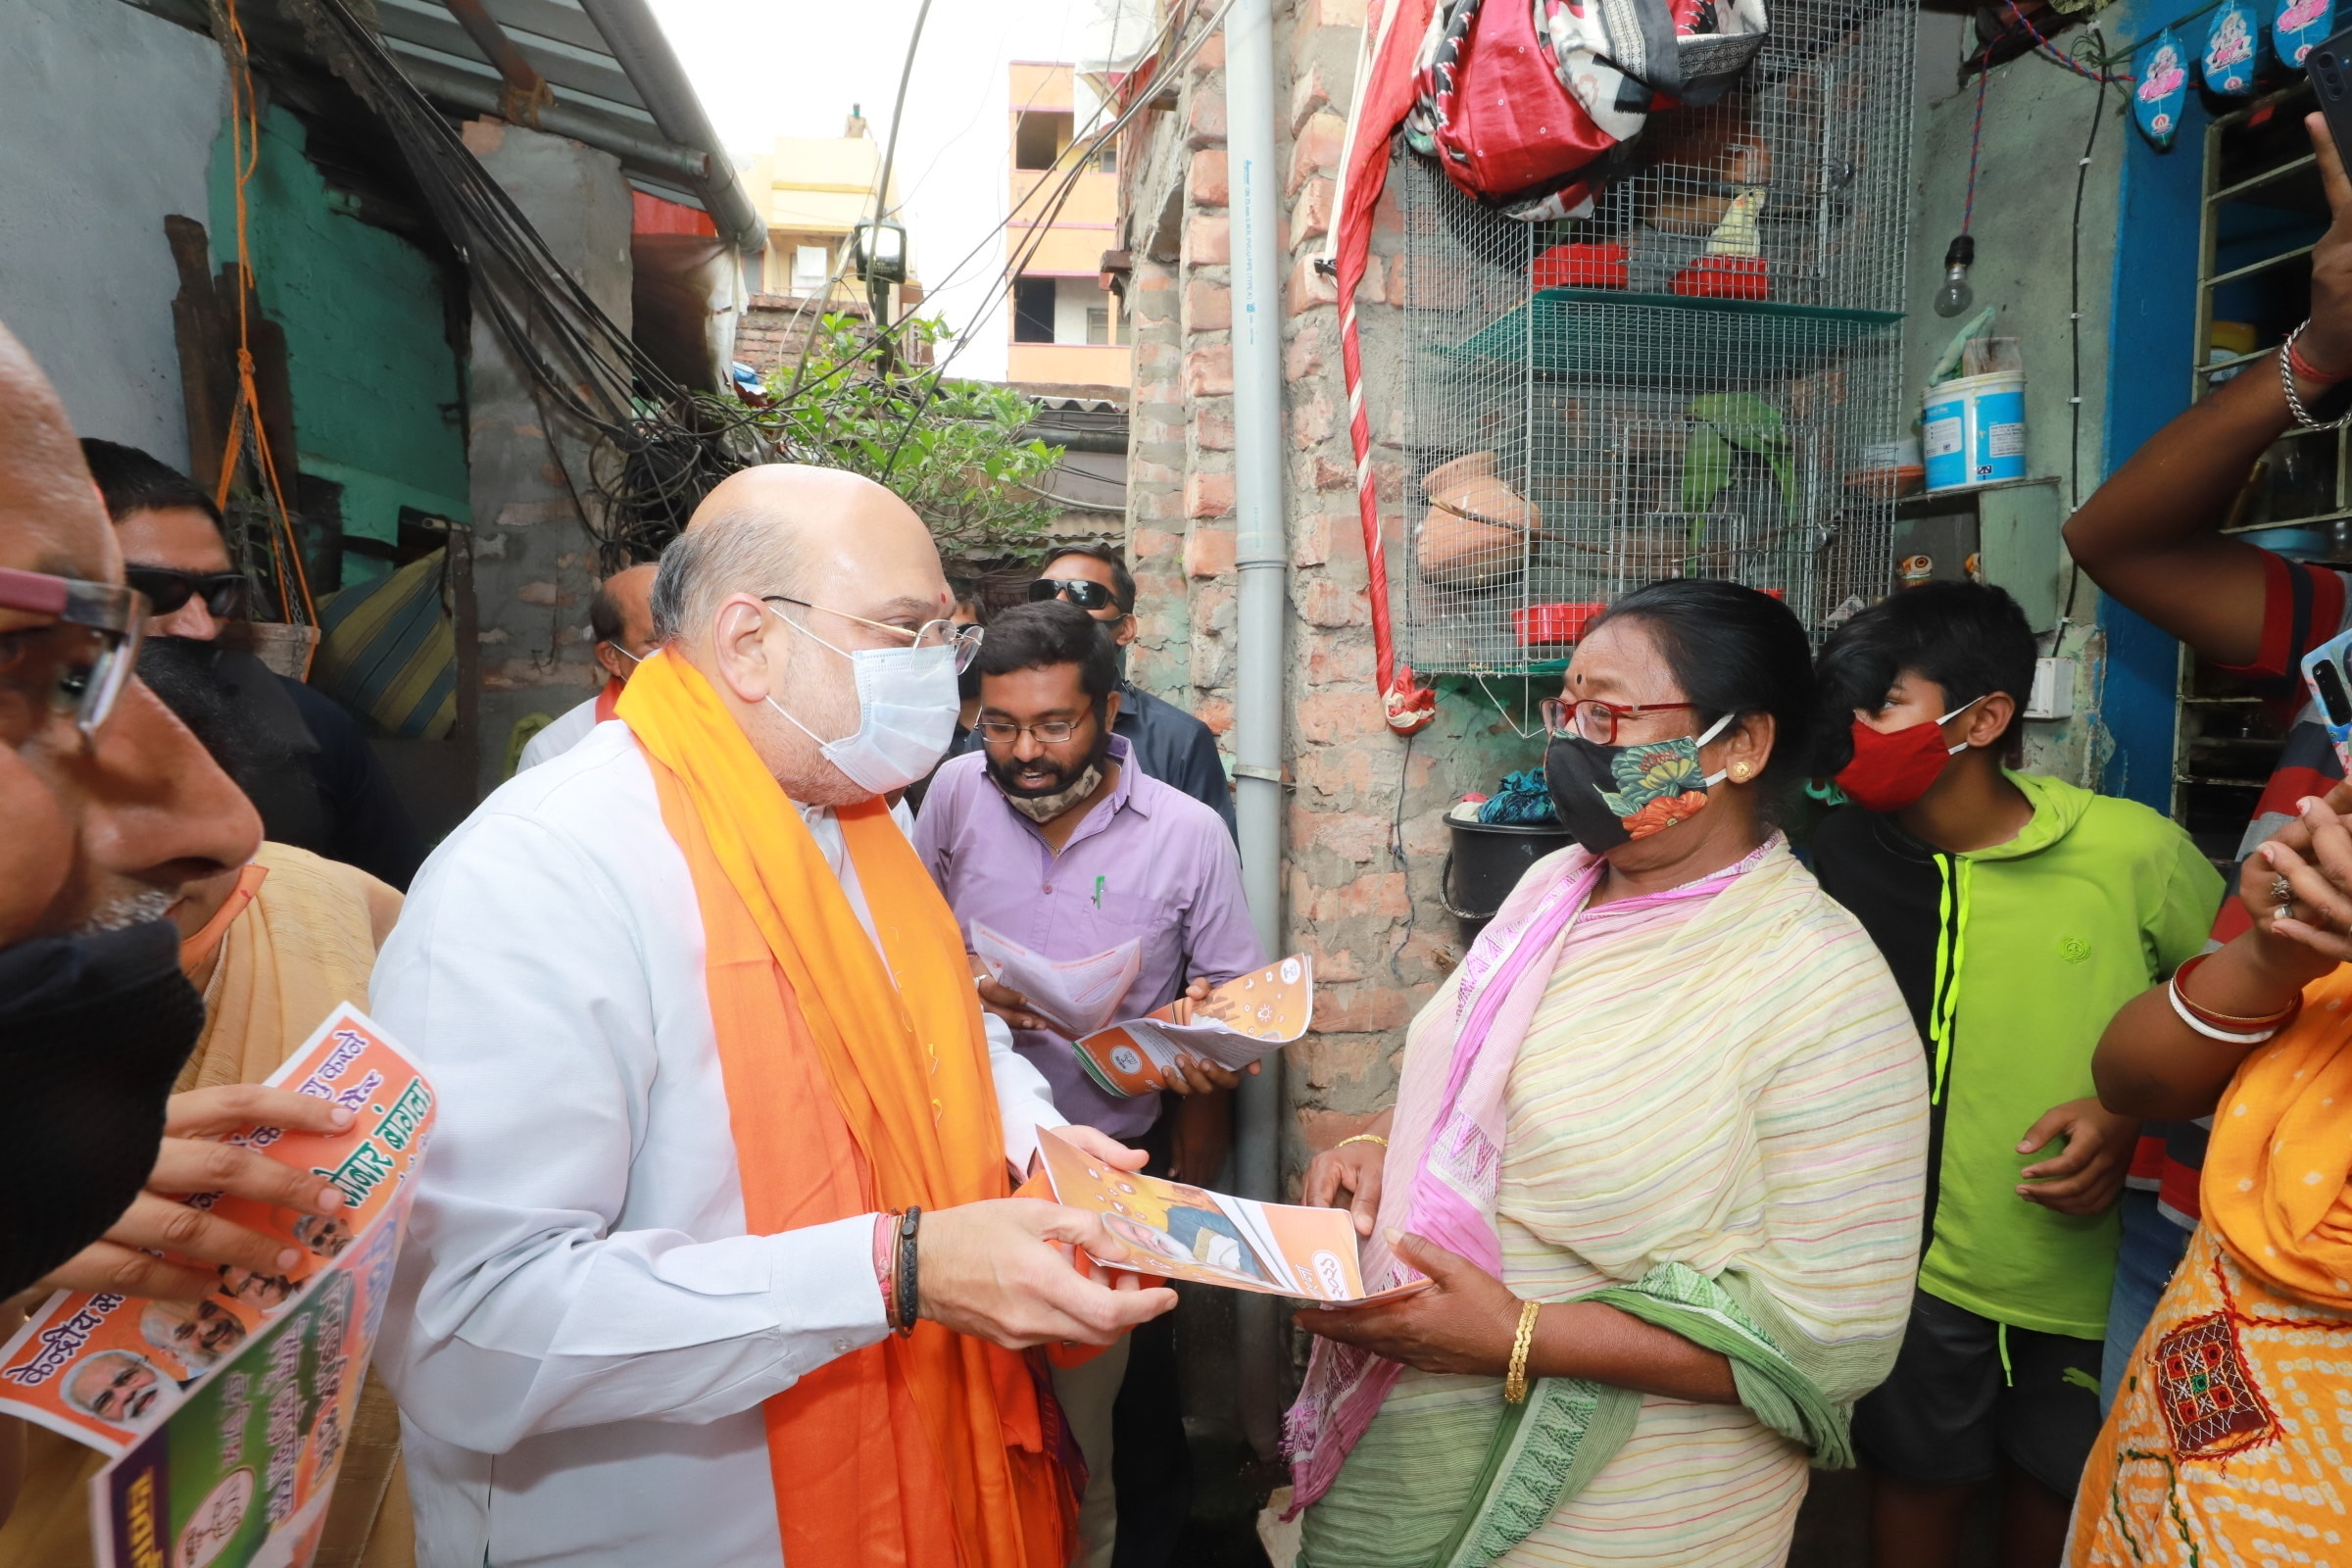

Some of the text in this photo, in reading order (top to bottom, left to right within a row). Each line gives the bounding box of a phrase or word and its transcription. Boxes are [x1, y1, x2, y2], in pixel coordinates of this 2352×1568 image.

[6, 1309, 102, 1384] केन्द्रीय
[318, 1032, 368, 1080] करने
[371, 1077, 432, 1151] बांगला
